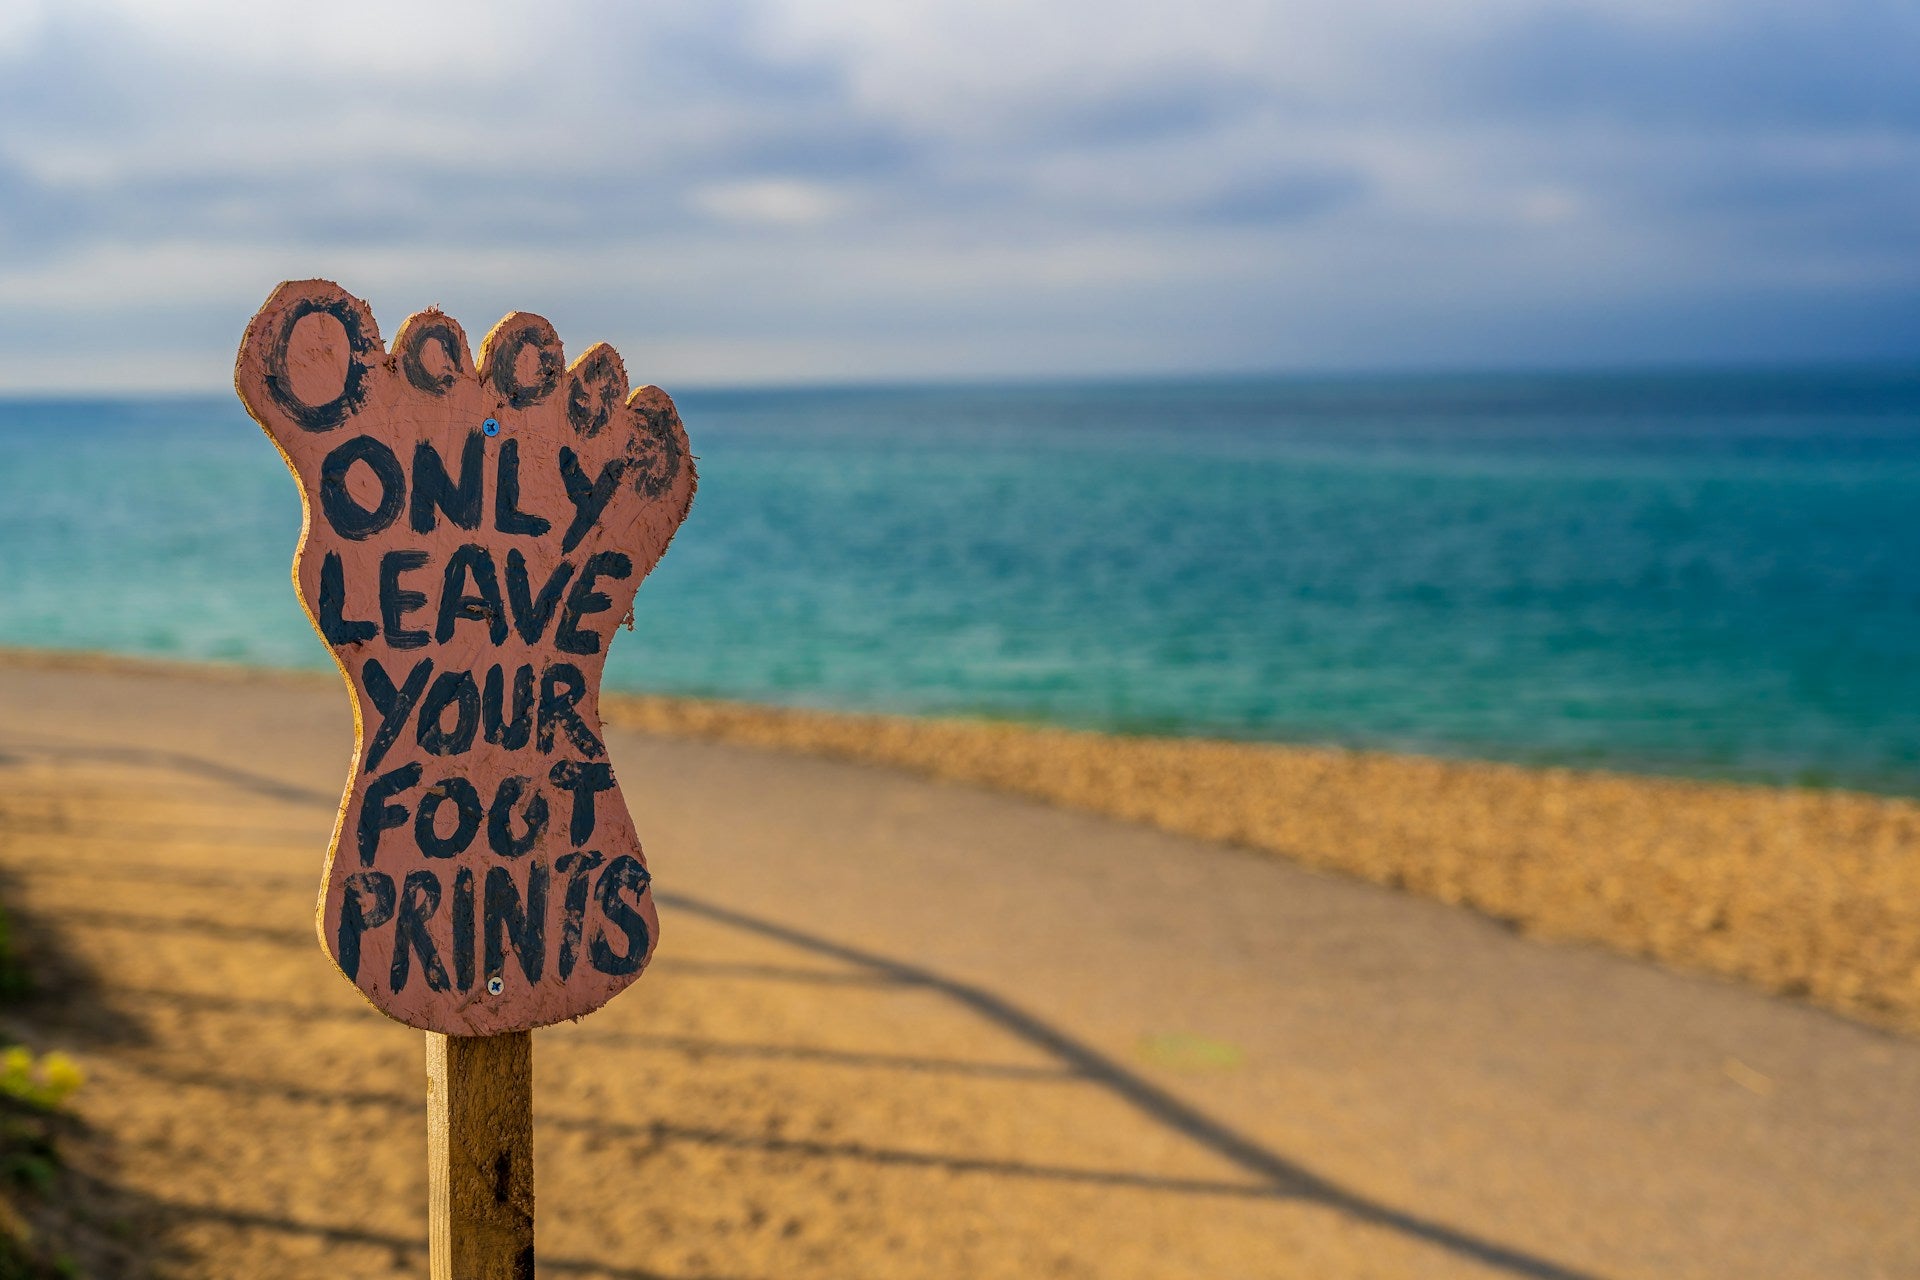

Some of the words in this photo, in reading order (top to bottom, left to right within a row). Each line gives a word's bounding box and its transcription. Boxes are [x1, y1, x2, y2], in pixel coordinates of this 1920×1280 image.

[319, 428, 627, 556] ONLY
[319, 543, 633, 655] LEAVE
[361, 657, 607, 774] YOUR
[357, 760, 616, 867] FOOT
[339, 850, 652, 995] PRINTS
